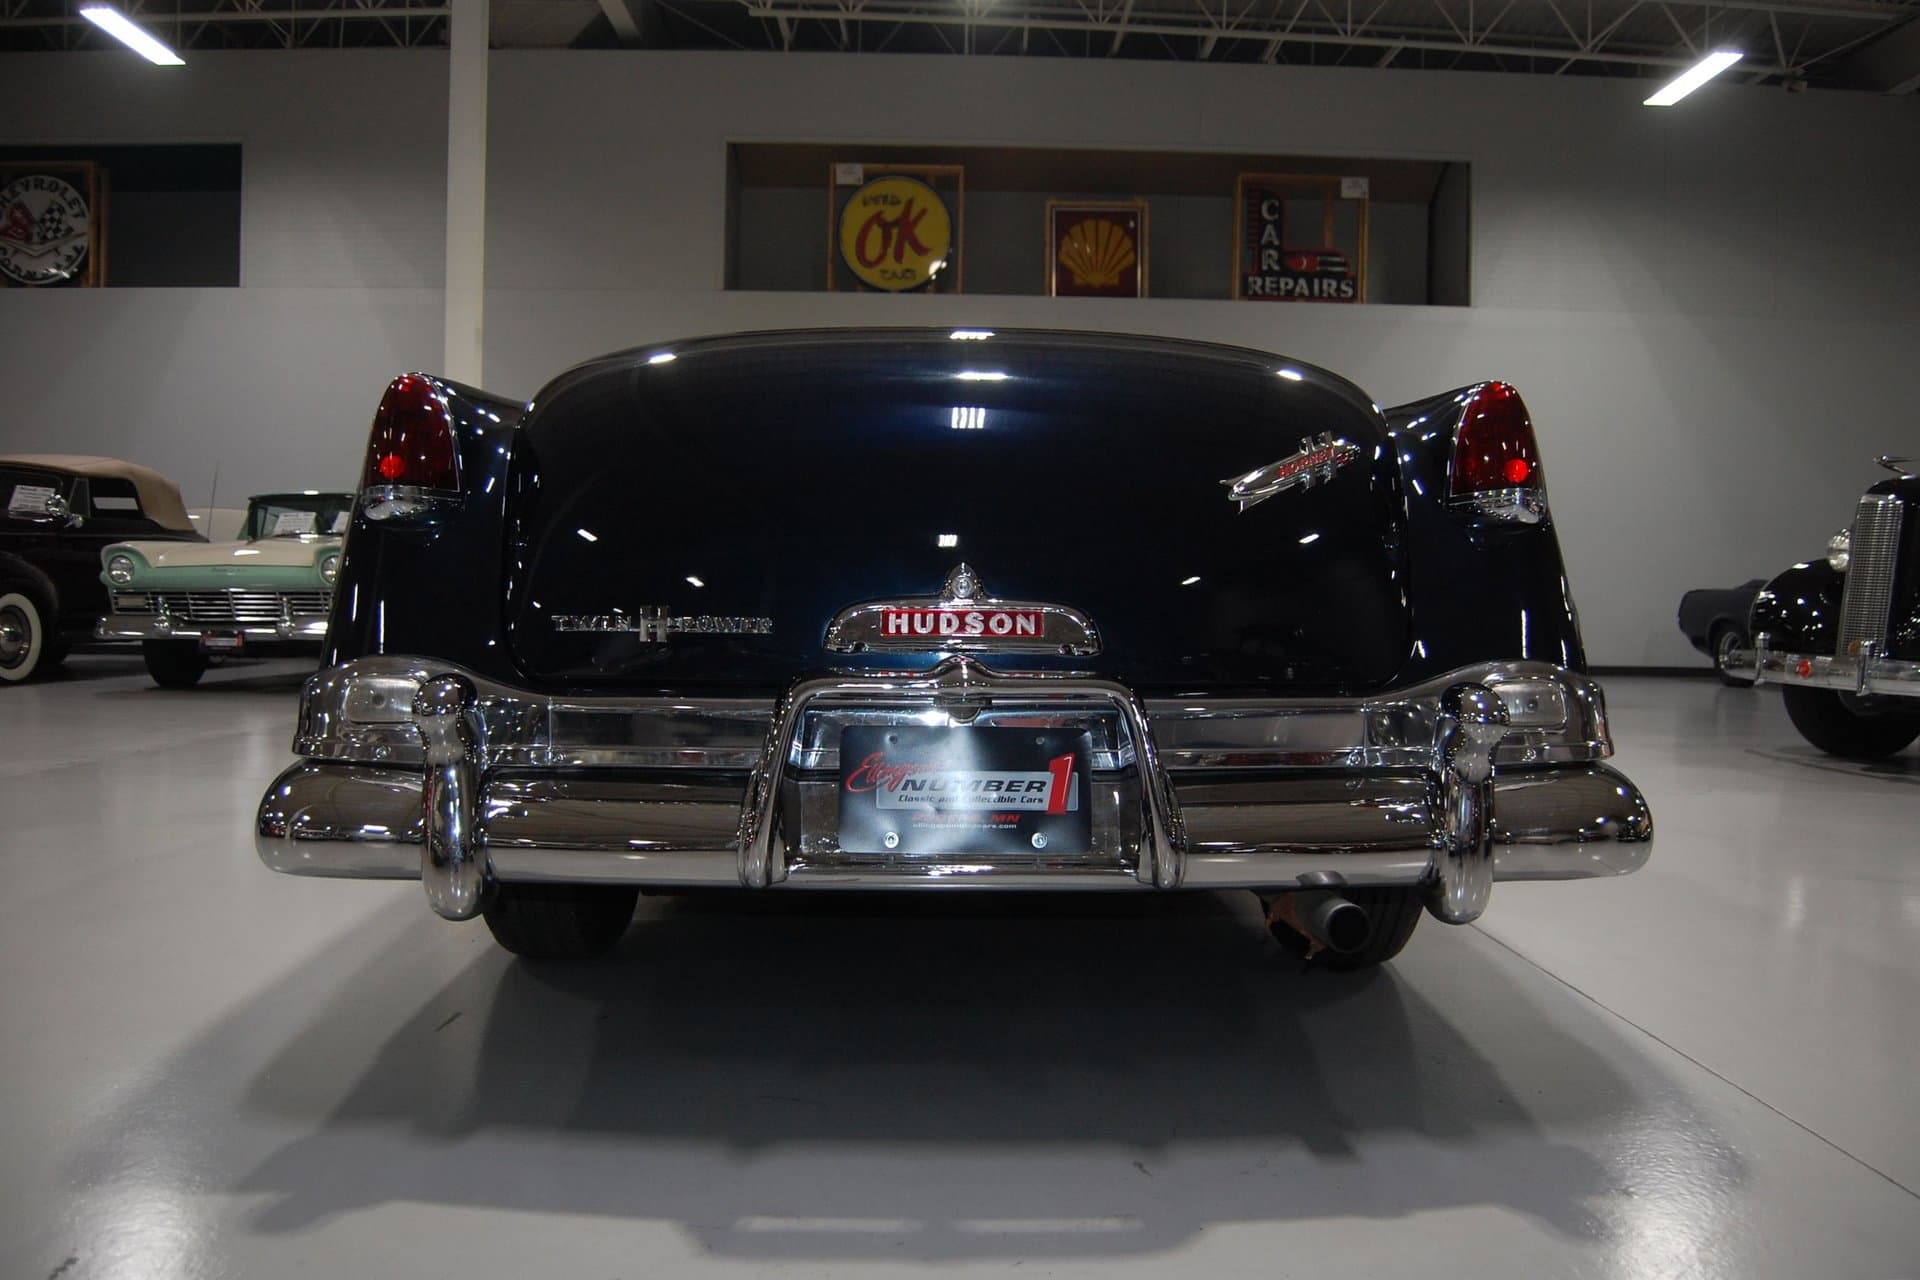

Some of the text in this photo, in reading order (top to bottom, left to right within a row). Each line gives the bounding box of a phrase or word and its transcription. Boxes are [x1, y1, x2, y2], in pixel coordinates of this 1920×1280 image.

[0, 177, 86, 219] HEVROLET
[855, 197, 934, 268] OK
[1261, 199, 1280, 271] CAR
[1248, 276, 1354, 299] REPAIRS
[888, 612, 1036, 635] HUDSON
[898, 794, 934, 803] Classic
[961, 795, 1016, 804] ollectible
[1020, 795, 1044, 804] Cars
[901, 753, 1076, 814] NUMBER 1
[991, 814, 1021, 823] MN
